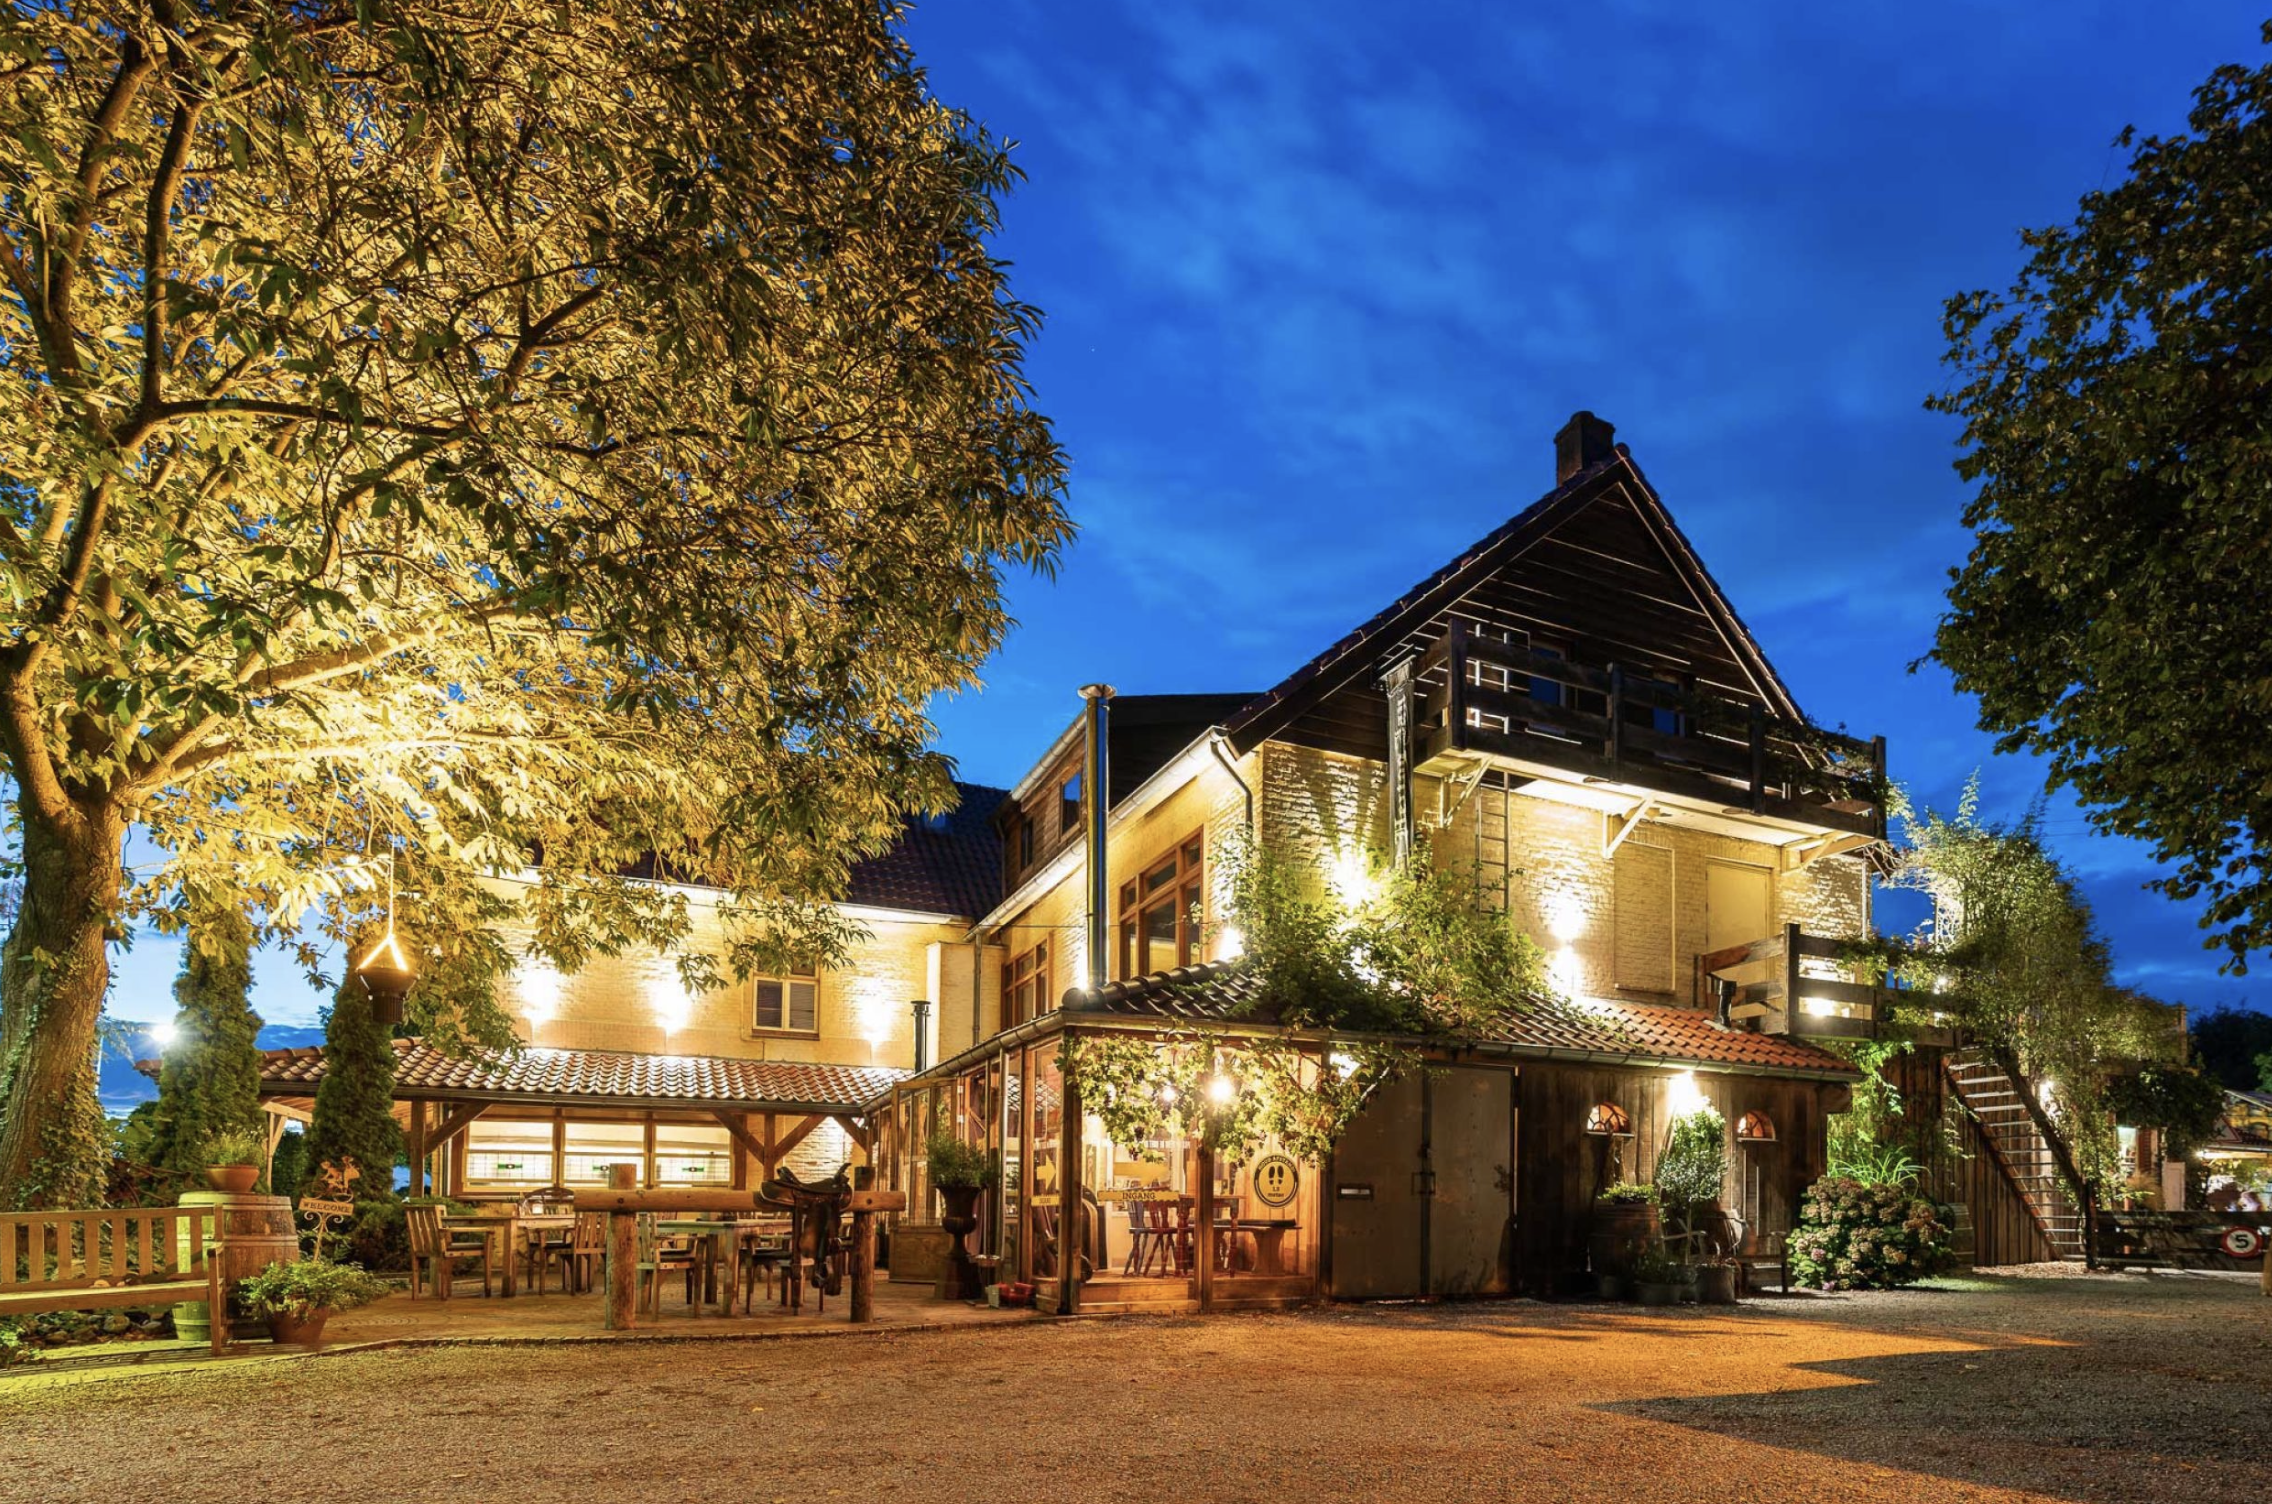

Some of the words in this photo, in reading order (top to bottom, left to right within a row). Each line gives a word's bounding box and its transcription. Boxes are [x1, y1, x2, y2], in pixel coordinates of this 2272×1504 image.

[1122, 1192, 1156, 1200] INGANG
[303, 1201, 350, 1213] WELCOME
[2235, 1234, 2249, 1249] 5
